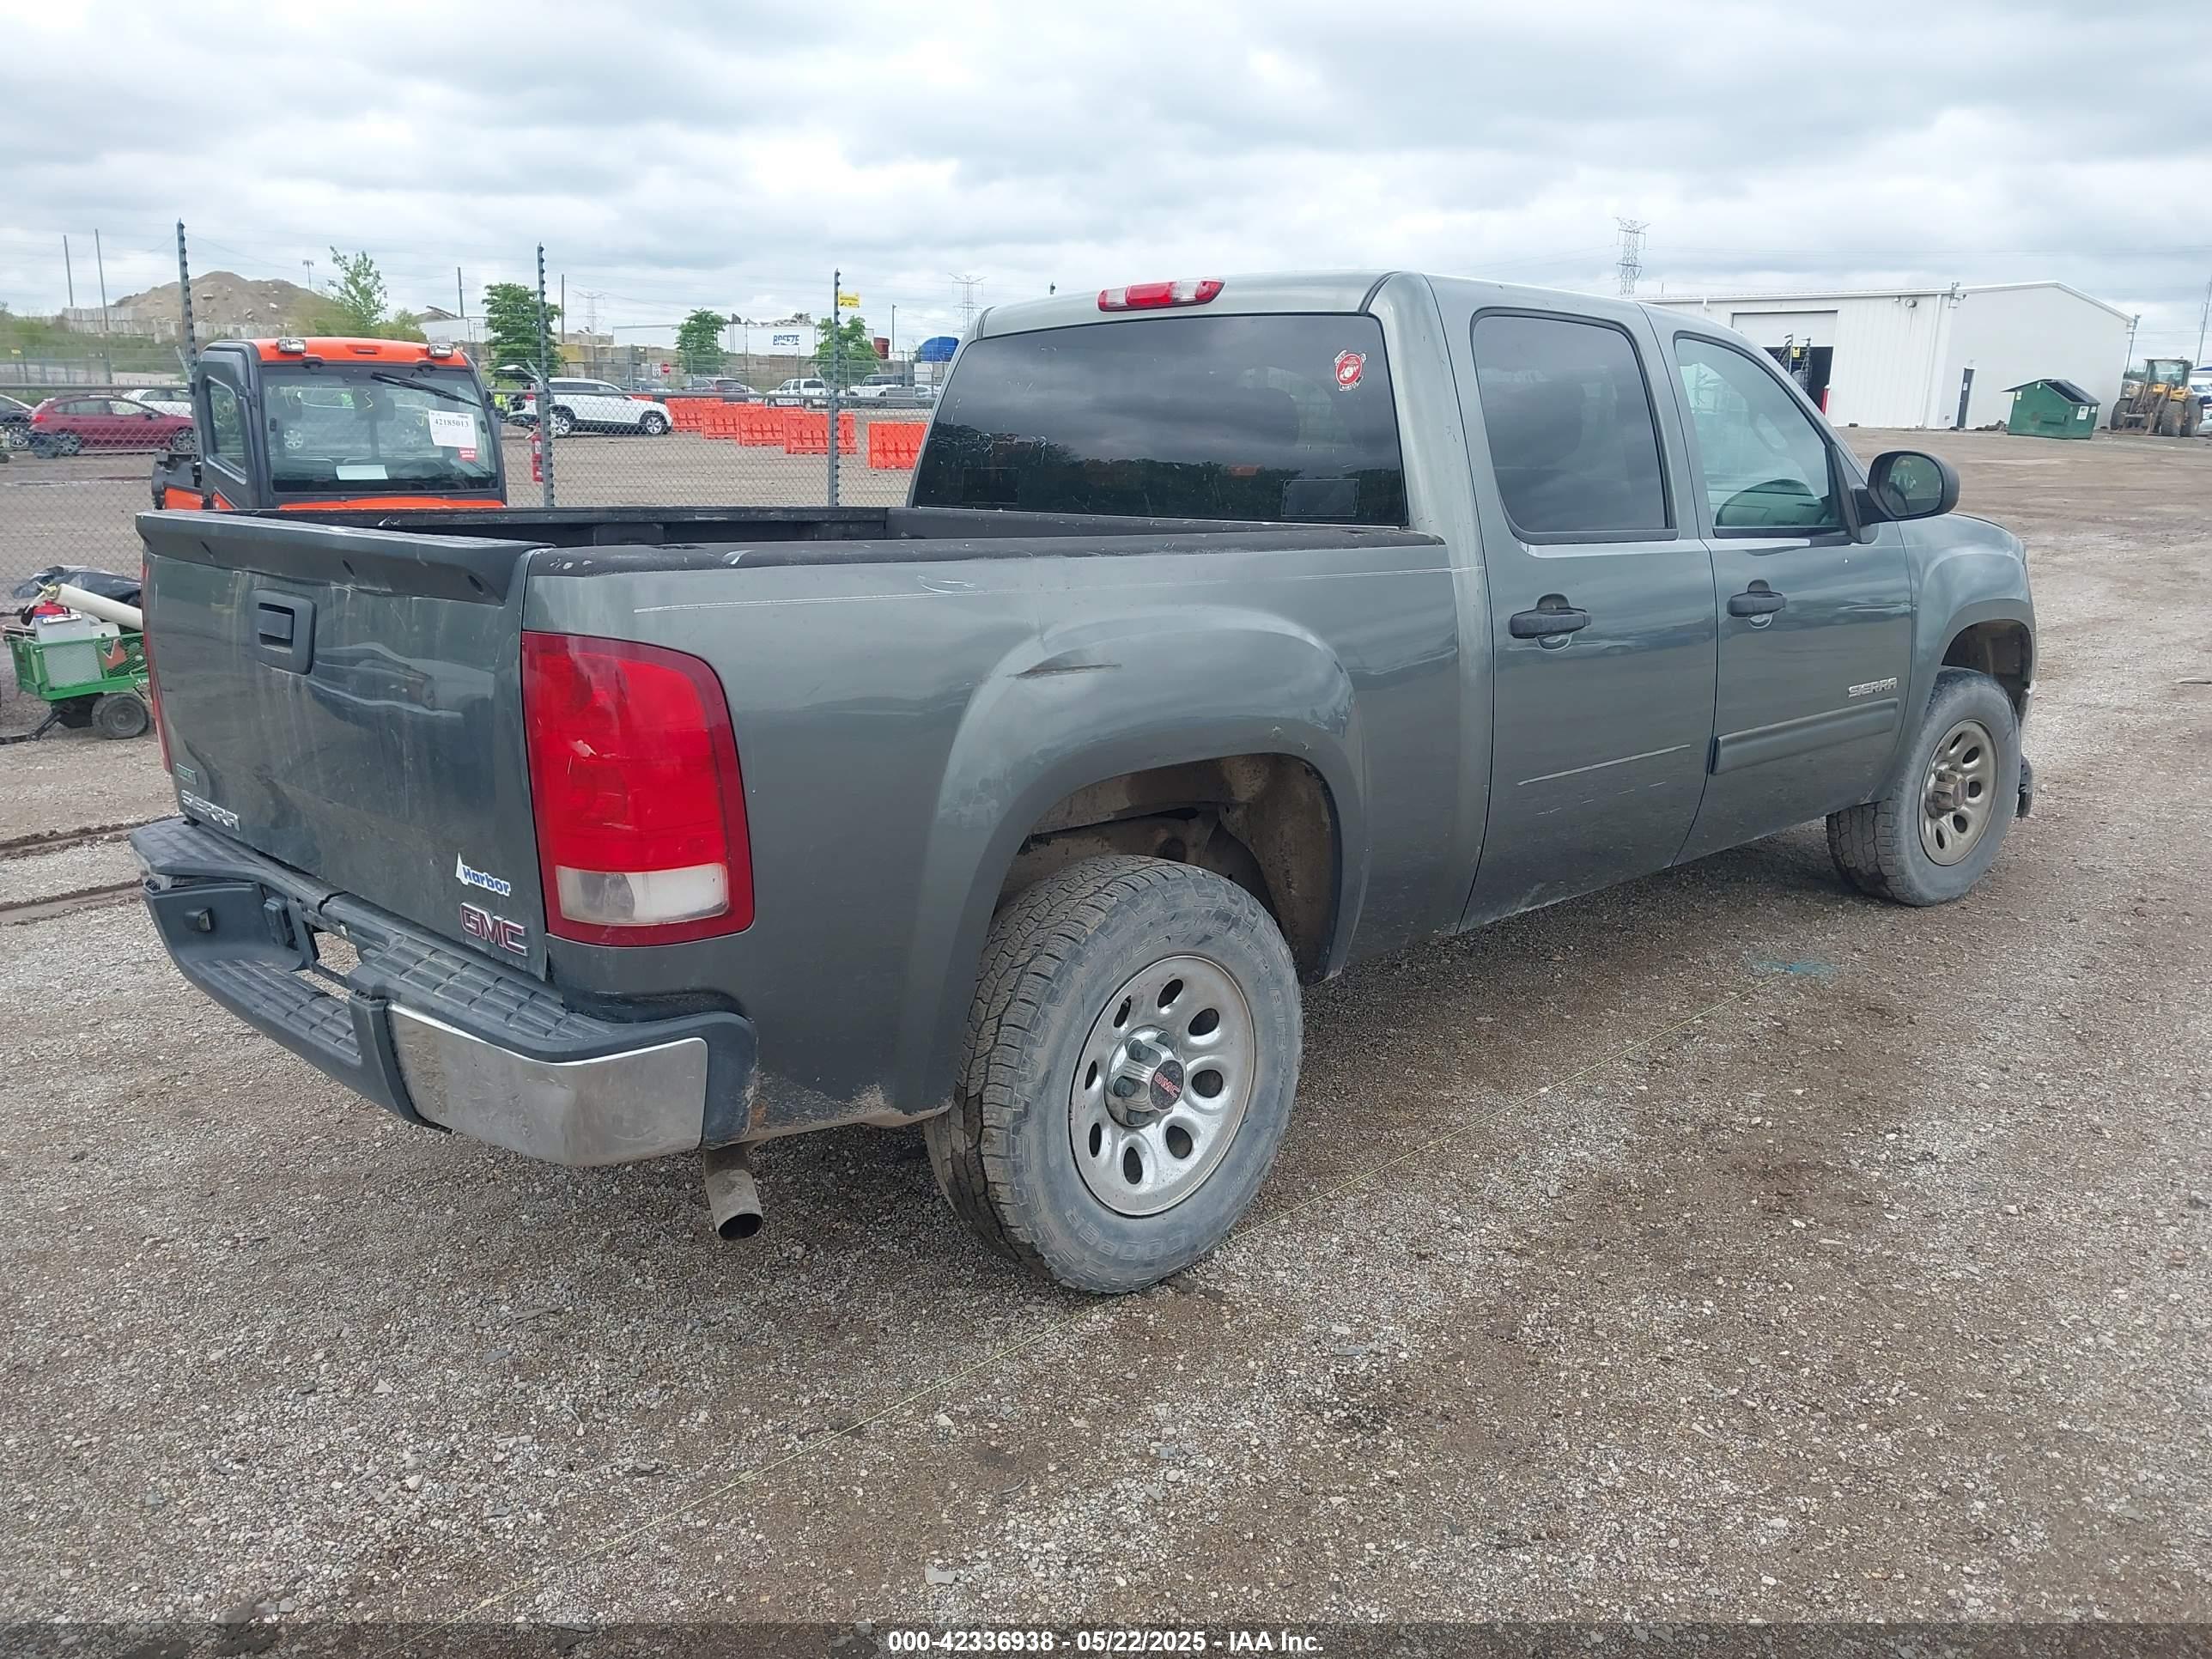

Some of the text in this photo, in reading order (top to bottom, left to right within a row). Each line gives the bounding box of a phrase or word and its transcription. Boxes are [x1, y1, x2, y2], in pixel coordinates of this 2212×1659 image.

[1848, 677, 1897, 698] SIERRA
[181, 789, 240, 831] SIERRA
[462, 866, 511, 895] Harbor
[460, 902, 529, 957] GMC
[1154, 1072, 1181, 1099] GMC
